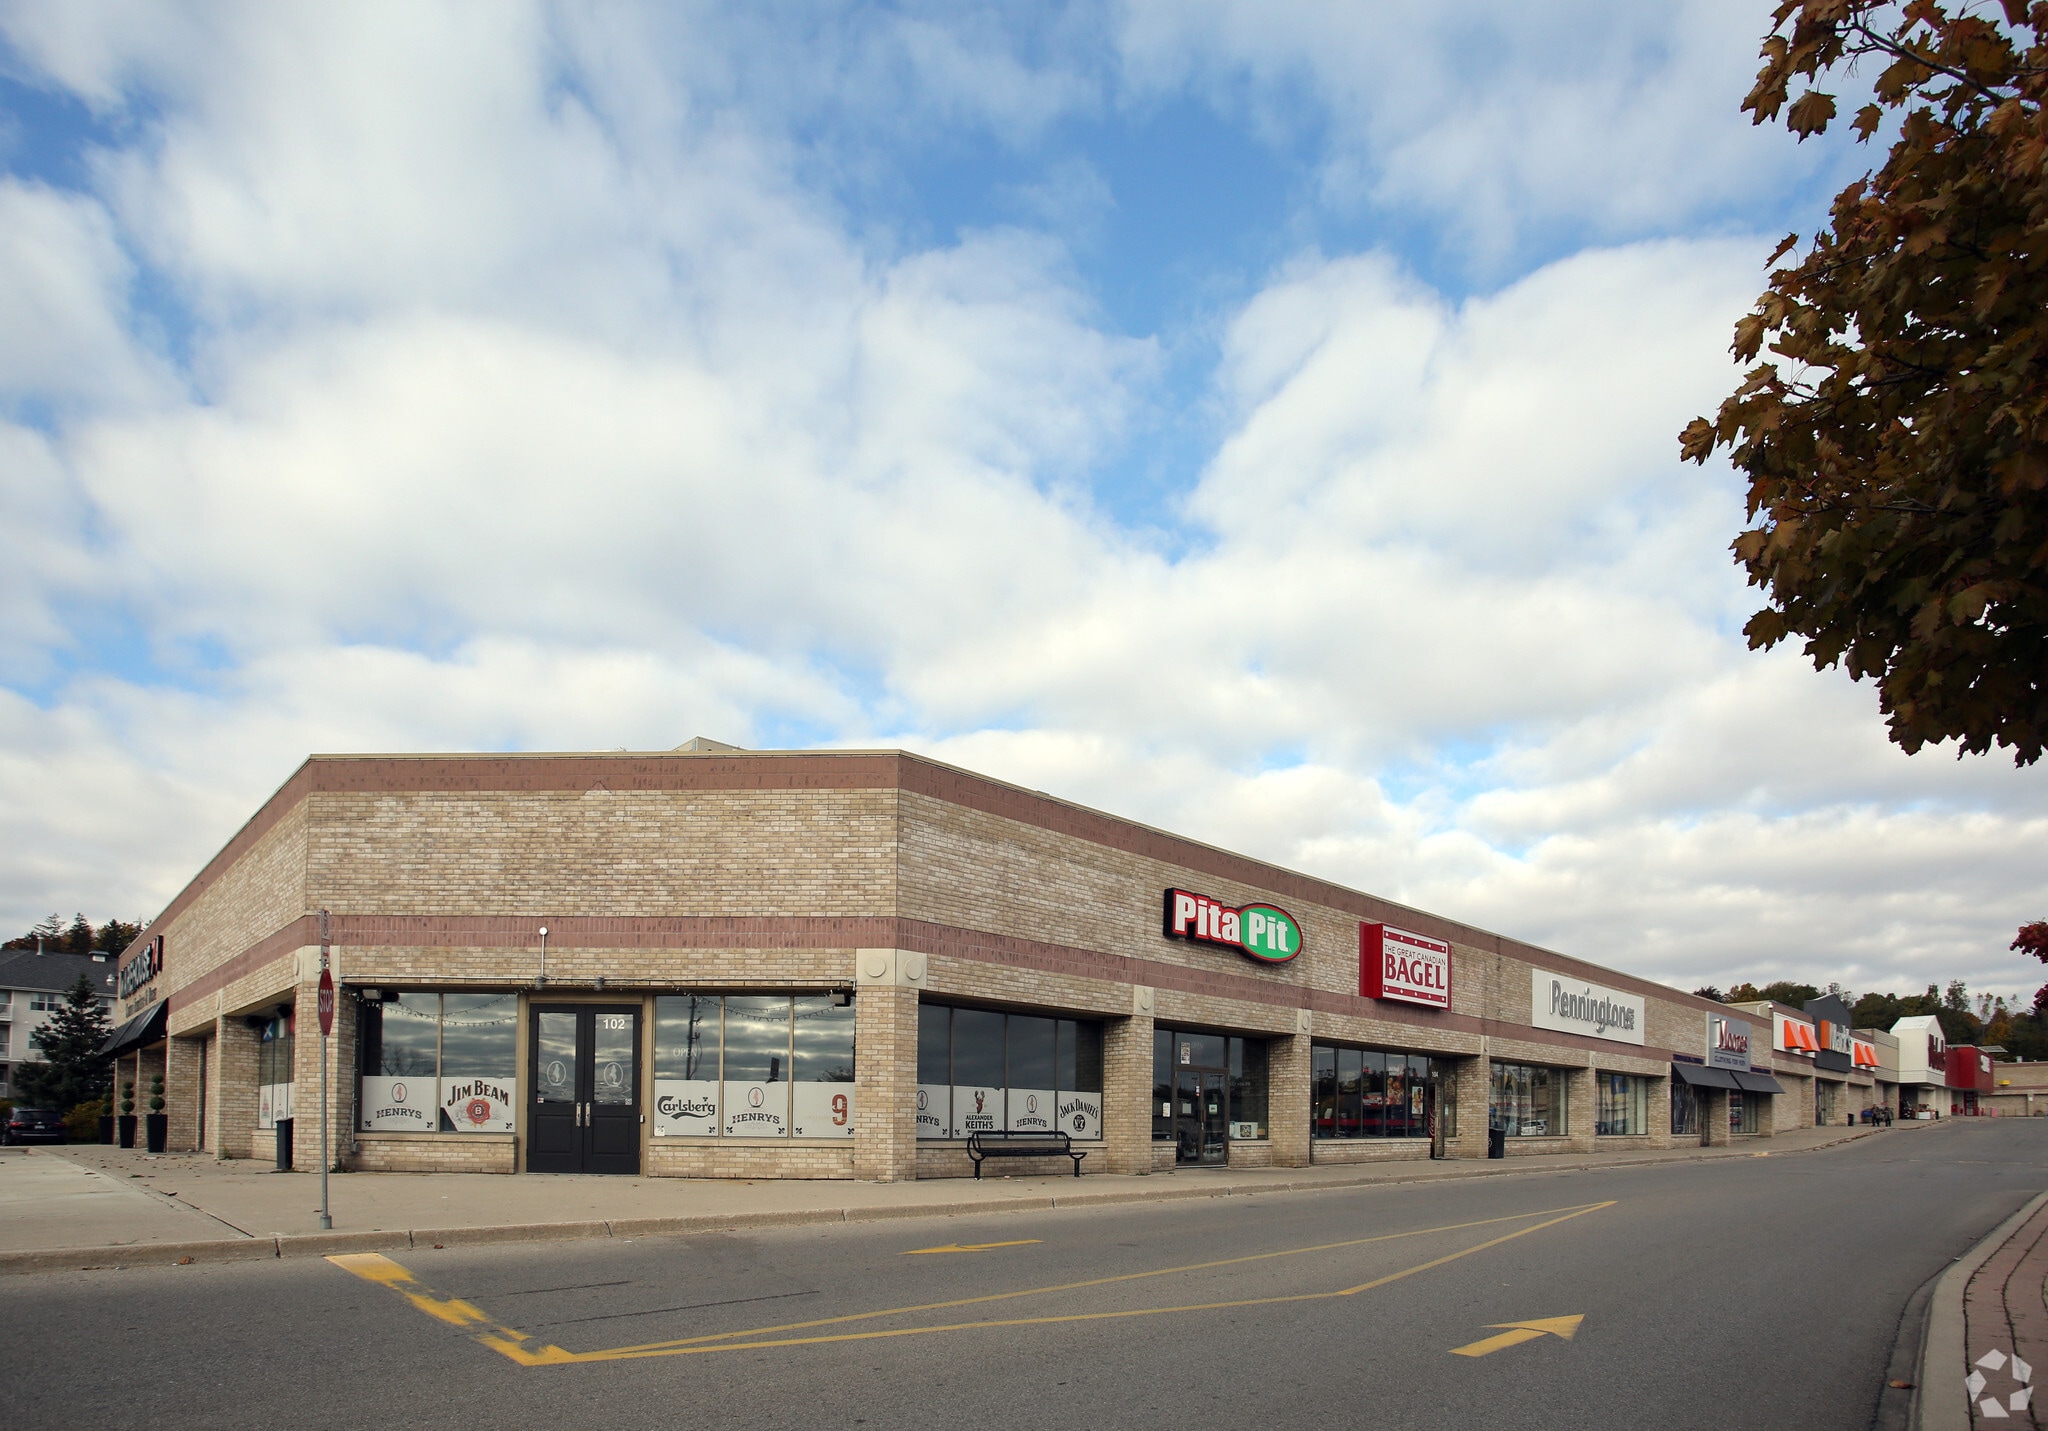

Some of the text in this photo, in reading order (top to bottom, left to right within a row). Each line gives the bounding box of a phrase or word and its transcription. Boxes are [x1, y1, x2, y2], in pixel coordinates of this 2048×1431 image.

[1174, 893, 1290, 952] Pita Pit
[1384, 944, 1446, 966] THE GREAT CANADIAN
[1384, 953, 1446, 990] BAGEL
[319, 988, 333, 1013] STOP
[1549, 979, 1635, 1034] Penningtons
[602, 1018, 626, 1030] 102
[672, 1047, 698, 1057] OPEN
[447, 1080, 509, 1107] JIM BEAM
[376, 1107, 423, 1120] HENRYS
[656, 1095, 716, 1118] Carlsberg
[832, 1093, 848, 1126] 9
[1059, 1098, 1100, 1120] JACK DANIEL'S
[731, 1112, 781, 1125] HENRYS
[916, 1114, 940, 1127] NRYS
[965, 1120, 994, 1130] KEITH'S
[1016, 1117, 1048, 1128] HENRYS
